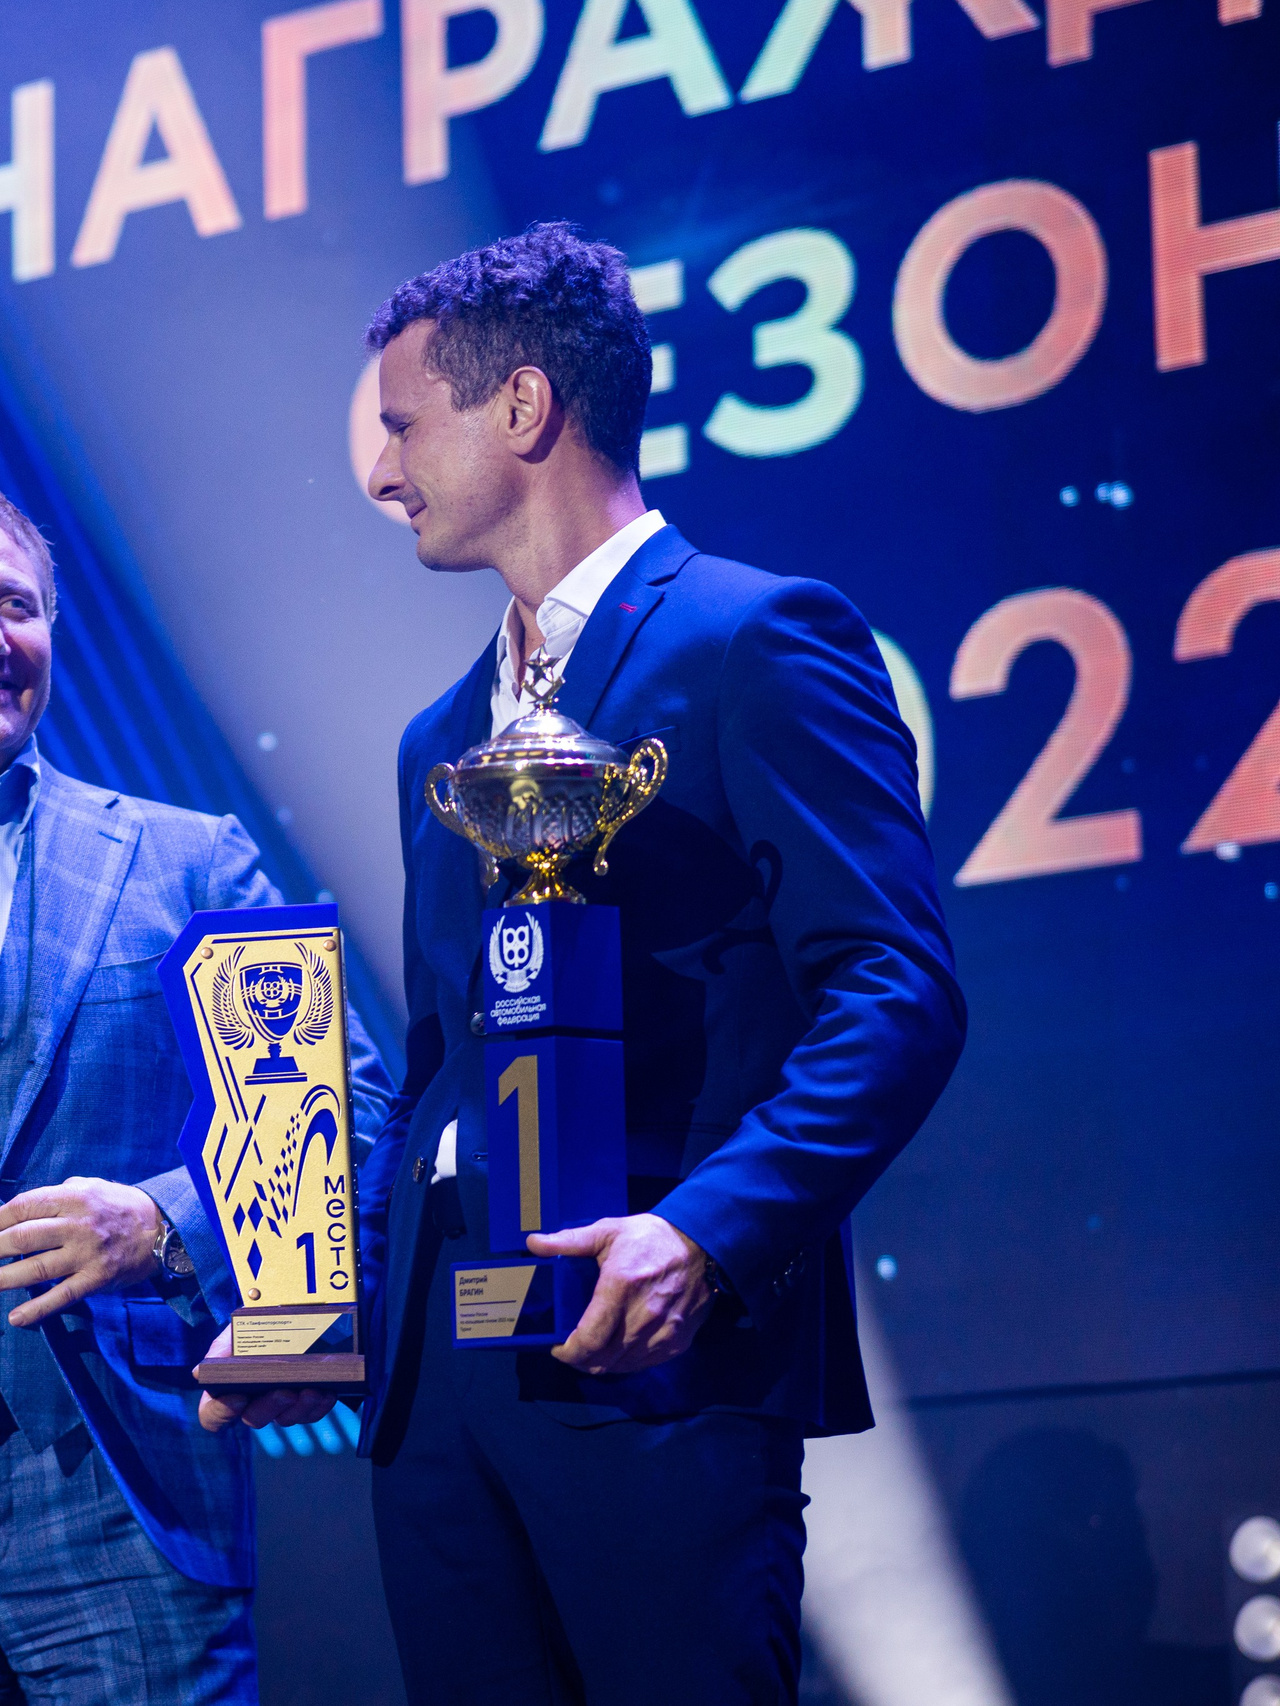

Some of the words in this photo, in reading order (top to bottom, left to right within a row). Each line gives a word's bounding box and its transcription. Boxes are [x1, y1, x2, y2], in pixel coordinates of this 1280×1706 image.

[495, 995, 541, 1010] российская
[490, 1003, 547, 1018] автомобильная
[497, 1012, 540, 1027] федерация
[498, 1055, 542, 1232] 1
[296, 1232, 317, 1294] 1
[459, 1274, 488, 1286] Дмитрий
[459, 1287, 484, 1297] БРАГИН
